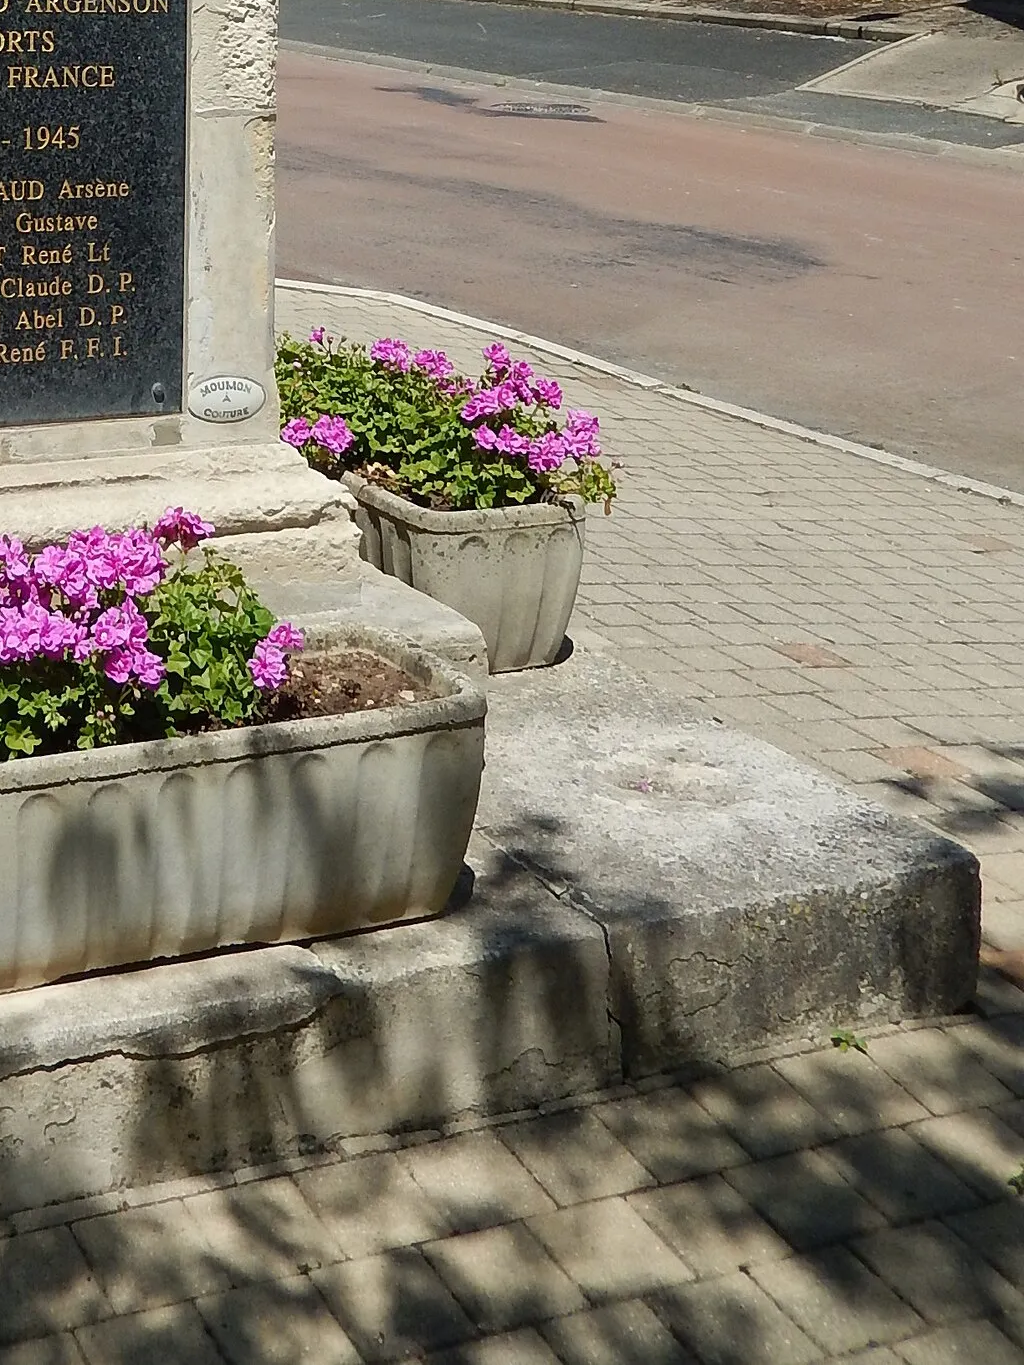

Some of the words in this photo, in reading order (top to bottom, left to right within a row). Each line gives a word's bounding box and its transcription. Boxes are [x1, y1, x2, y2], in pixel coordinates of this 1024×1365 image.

[7, 65, 116, 88] FRANCE
[23, 125, 81, 150] 1945
[58, 178, 130, 200] Arsène
[16, 213, 98, 234] Gustave
[22, 244, 73, 267] René
[87, 242, 111, 262] Lt
[0, 275, 73, 299] Claude
[15, 308, 64, 331] Abel
[203, 407, 249, 419] COUTURE
